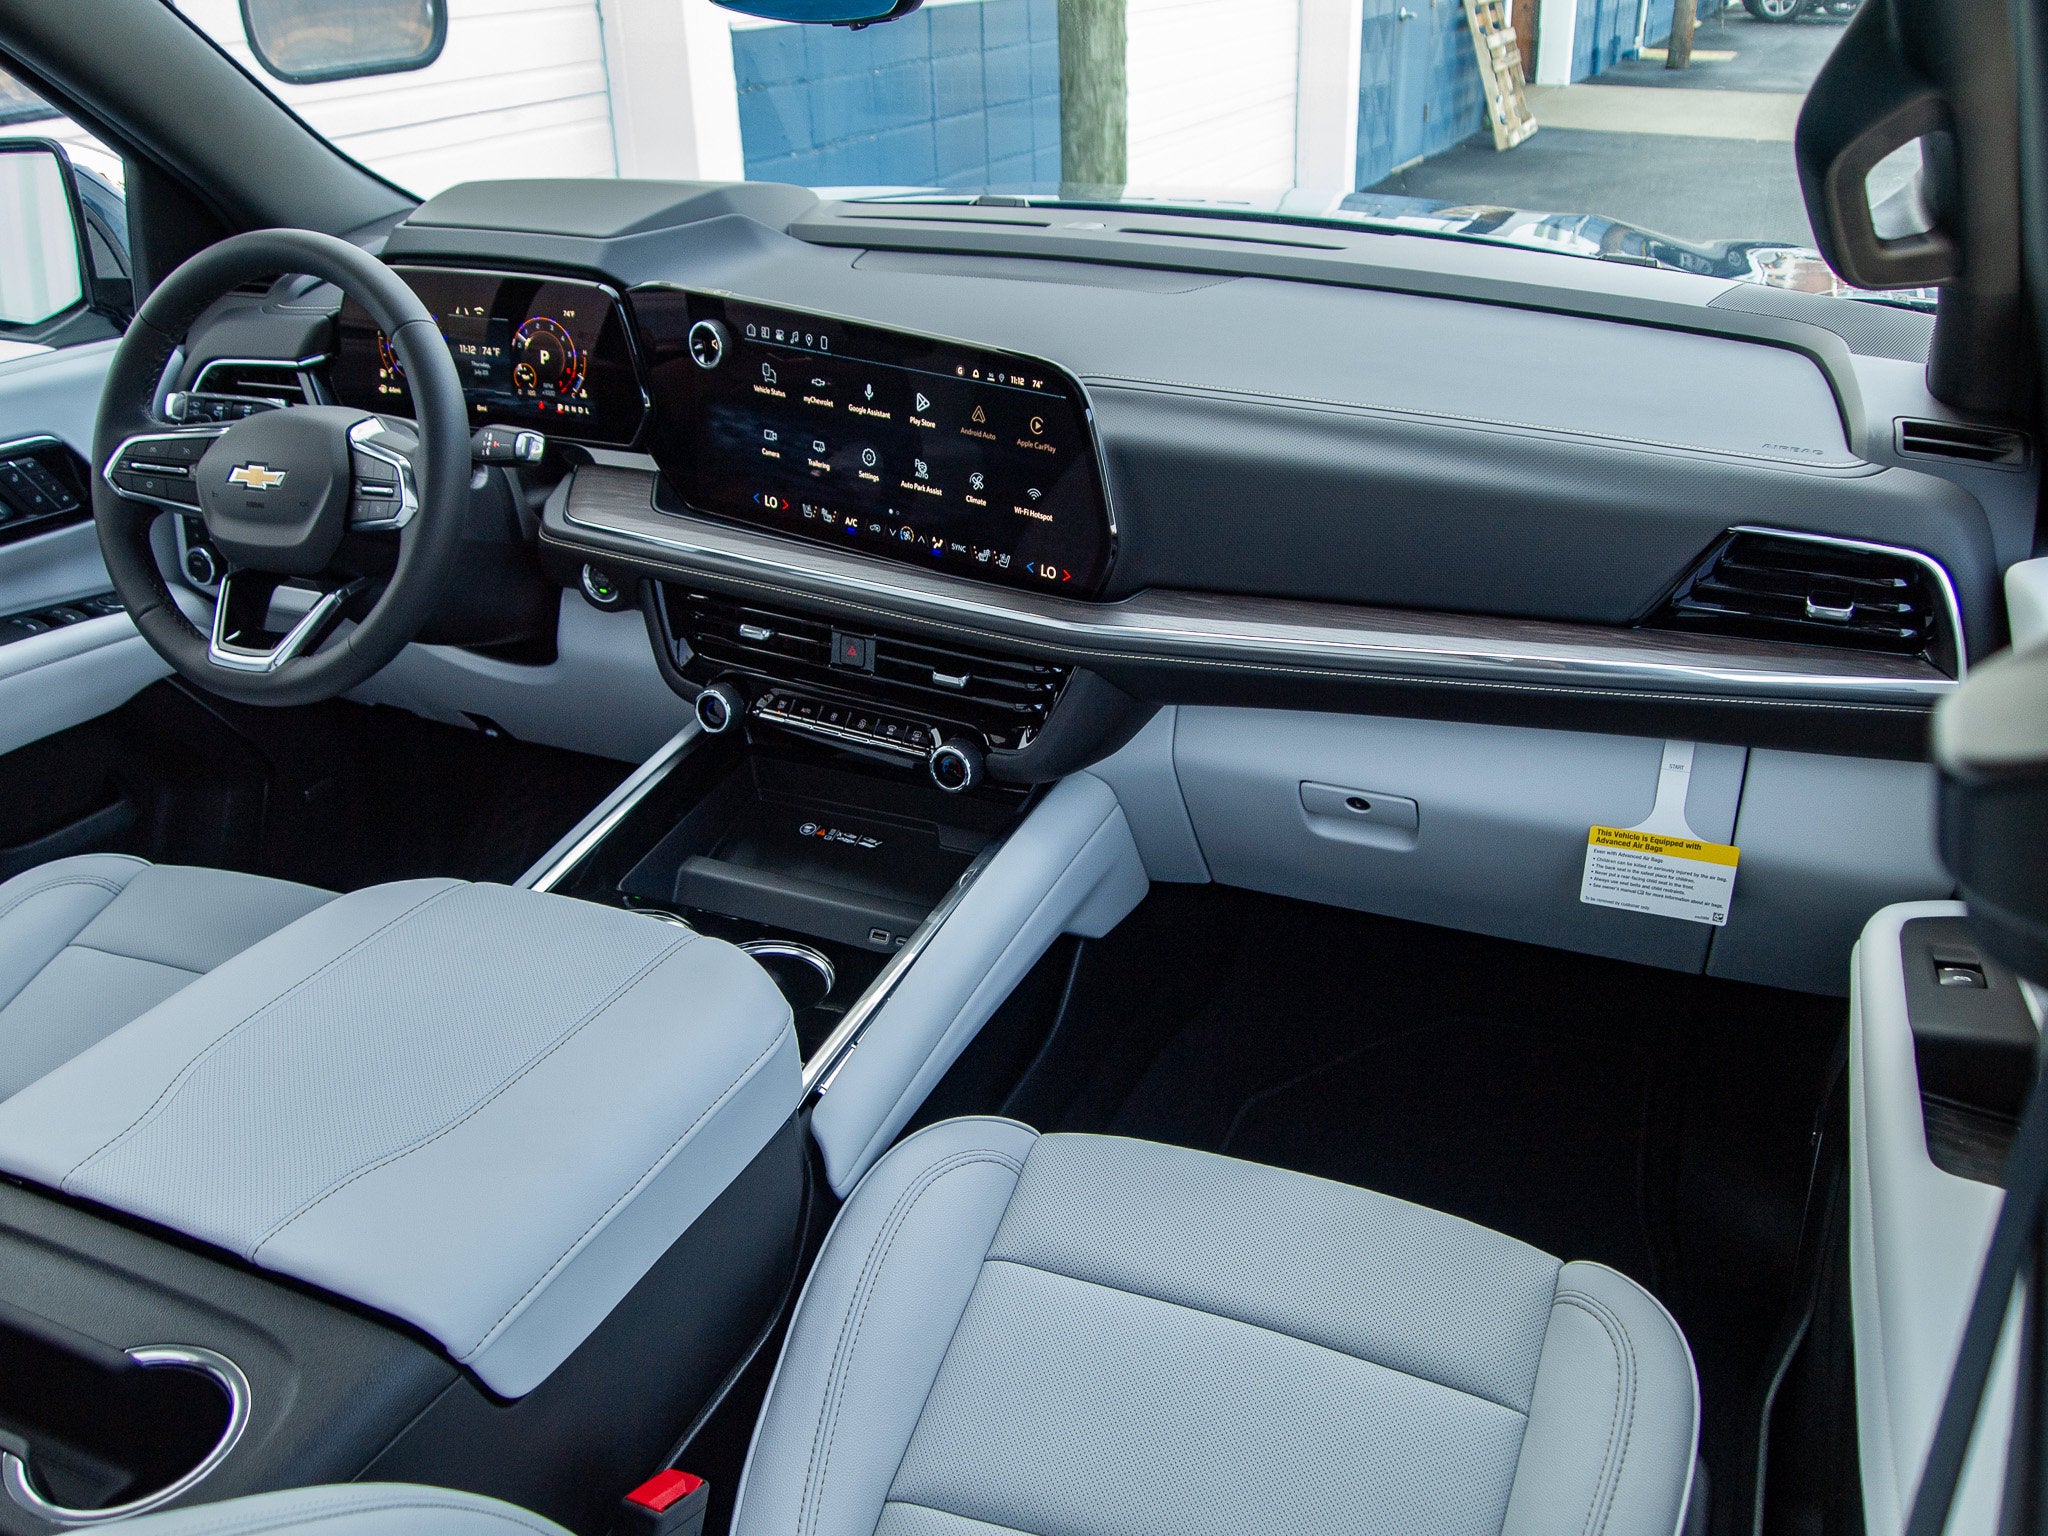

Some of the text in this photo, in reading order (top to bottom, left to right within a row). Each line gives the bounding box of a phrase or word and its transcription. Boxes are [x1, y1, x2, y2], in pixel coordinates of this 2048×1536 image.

[459, 344, 476, 355] 11:12
[540, 349, 551, 365] P
[1010, 375, 1025, 386] 11:12
[1032, 379, 1044, 389] 74°
[753, 384, 786, 398] Vehicle Status
[803, 395, 834, 408] myChevrolet
[848, 404, 891, 419] Google Assistant
[909, 416, 936, 429] Play Store
[960, 427, 996, 440] Android Auto
[1016, 438, 1057, 454] Apple CarPlay
[1762, 443, 1824, 455] AIRBAG
[761, 448, 780, 458] Camera
[808, 458, 831, 472] Trailering
[858, 470, 879, 483] Settings
[900, 480, 943, 496] Auto Park Assist
[764, 494, 778, 509] LO
[965, 495, 987, 506] Climate
[1014, 506, 1053, 522] Wi-Fi Hotspot
[844, 516, 858, 527] A/C
[951, 543, 967, 553] SYNC
[1040, 564, 1057, 579] LO
[1596, 836, 1663, 853] Advanced Air Bags
[1597, 829, 1612, 837] This
[1614, 831, 1640, 841] Vehicle
[1650, 836, 1684, 847] Equipped
[1686, 842, 1702, 850] with
[1621, 874, 1645, 883] rear-facing
[1664, 894, 1689, 903] information
